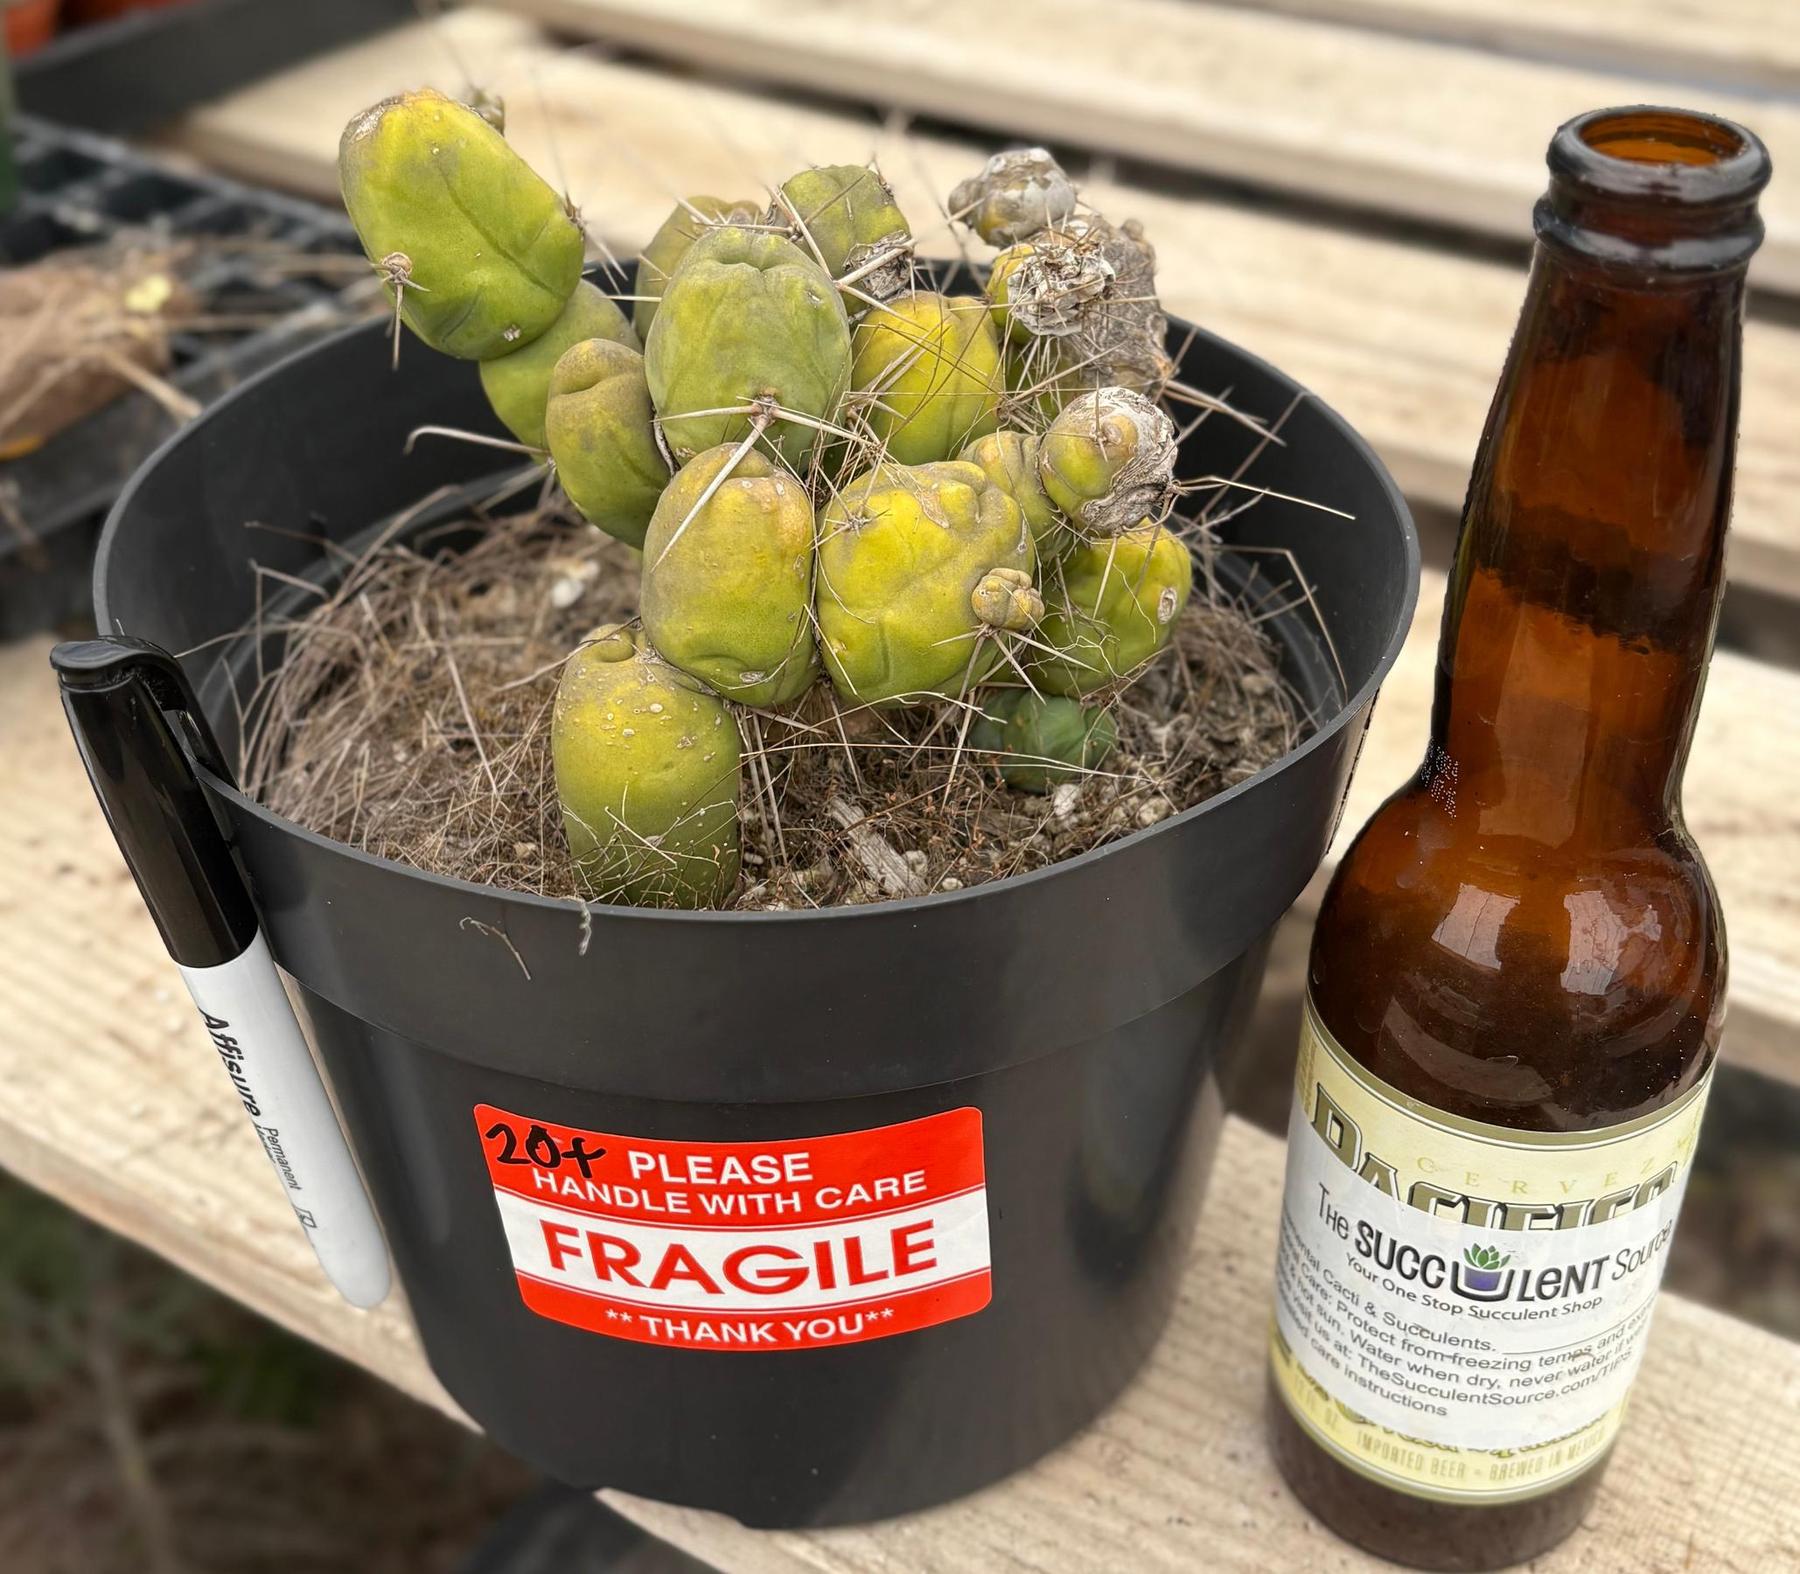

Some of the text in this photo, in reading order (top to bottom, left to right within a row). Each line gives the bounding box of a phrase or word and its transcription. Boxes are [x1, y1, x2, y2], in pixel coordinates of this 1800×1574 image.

[485, 1122, 607, 1179] 20+
[627, 1150, 815, 1186] PLEASE
[532, 1168, 928, 1217] HANDLE WITH CARE
[539, 1218, 938, 1295] FRAGILE
[1346, 1252, 1379, 1283] Your
[1382, 1278, 1417, 1302] One
[1421, 1294, 1464, 1316] Stop
[1468, 1304, 1558, 1321] Succulent
[1561, 1297, 1603, 1315] Shop
[639, 1315, 777, 1343] THANK
[1322, 1268, 1497, 1352] Cacti & Succulents.
[1336, 1300, 1397, 1347] Protect
[1401, 1338, 1447, 1363] from
[1451, 1352, 1532, 1373] freezing
[1597, 1324, 1626, 1350] and
[1310, 1337, 1341, 1370] care
[1344, 1364, 1449, 1417] instructions
[1350, 1329, 1405, 1366] Water
[1407, 1361, 1460, 1384] when
[1466, 1374, 1501, 1391] dry,
[1509, 1370, 1563, 1388] never
[1567, 1349, 1612, 1377] water
[1356, 1430, 1425, 1472] IMPORTED
[1430, 1456, 1467, 1480] BEER
[1489, 1455, 1544, 1482] BREWED
